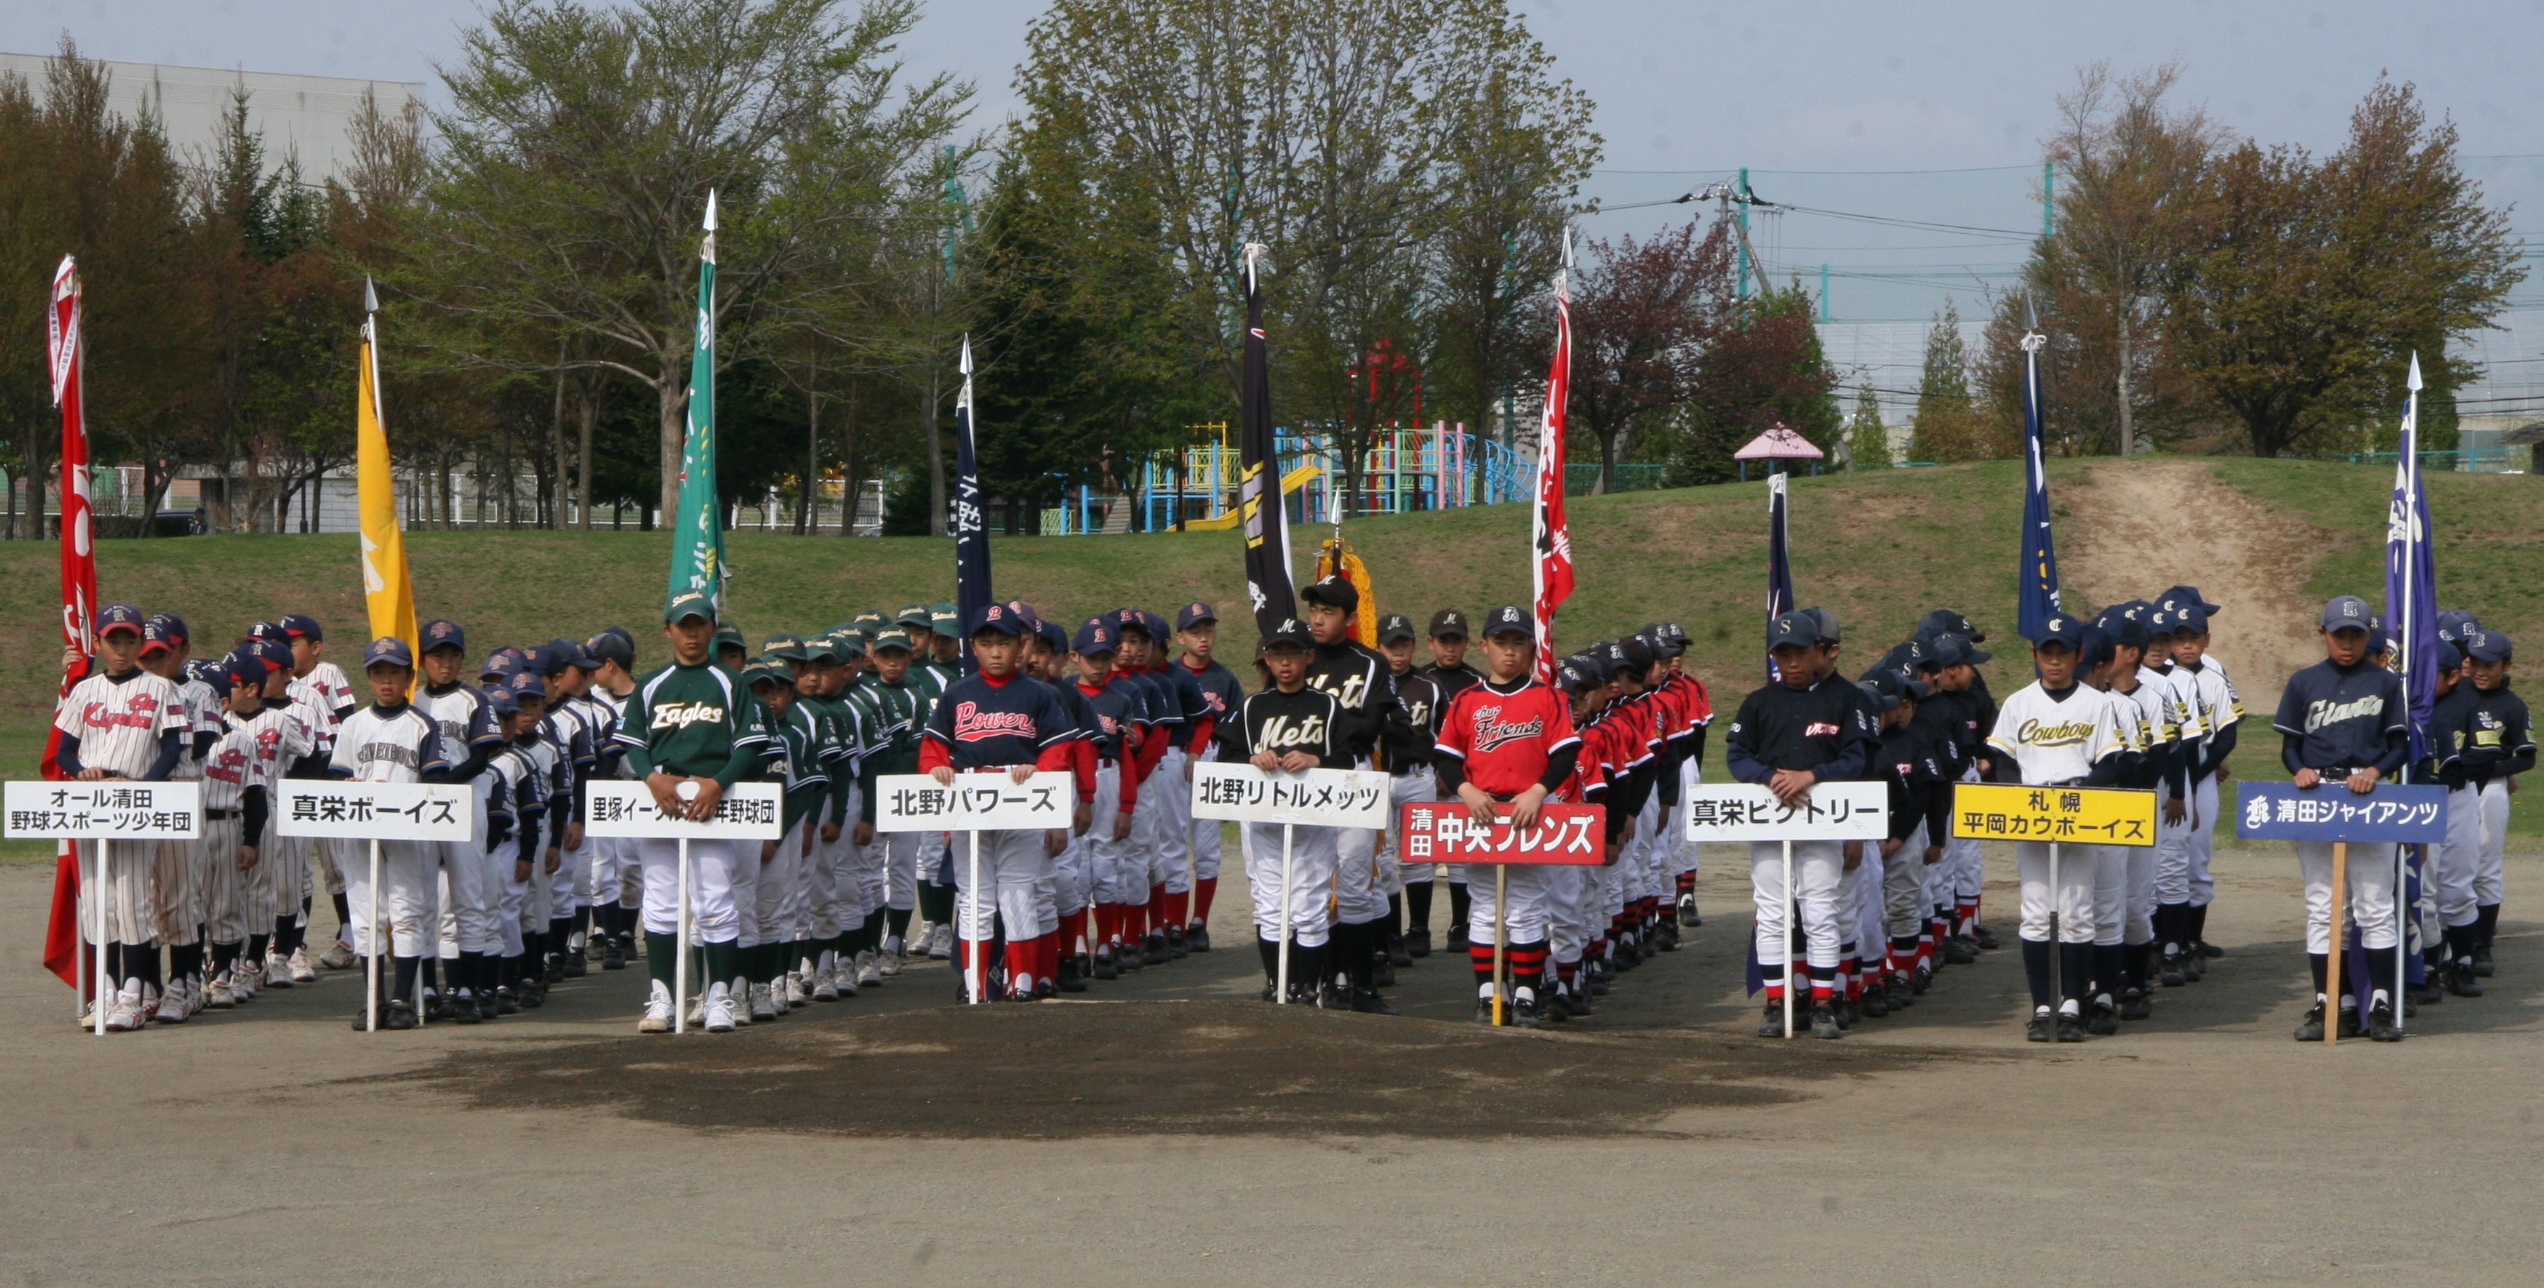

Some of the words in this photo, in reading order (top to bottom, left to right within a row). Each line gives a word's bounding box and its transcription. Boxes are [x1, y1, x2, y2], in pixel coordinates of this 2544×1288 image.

[986, 606, 1002, 621] P
[1277, 618, 1296, 633] M
[1780, 619, 1792, 635] S
[650, 701, 723, 730] Eagles
[954, 700, 1037, 738] Powers
[2304, 694, 2385, 735] Giants
[1253, 714, 1325, 755] Mets
[1474, 715, 1544, 746] Friends
[2017, 718, 2097, 745] Cowboys
[50, 788, 153, 809] オール清田
[890, 785, 1057, 817] 北野パワーズ
[1199, 776, 1380, 812] 北野リトルメッツ
[2028, 790, 2081, 813] 札幌
[11, 810, 191, 832] 野球スポーツ少年団
[291, 794, 458, 825] 真栄ボーイズ
[1692, 797, 1880, 827] 真栄ビクトリー
[2276, 798, 2439, 825] 清田ジャイアンツ
[1410, 808, 1434, 857] 清田
[1437, 811, 1595, 854] 中央フレンズ
[1963, 812, 2147, 840] 平岡カウボーイズ
